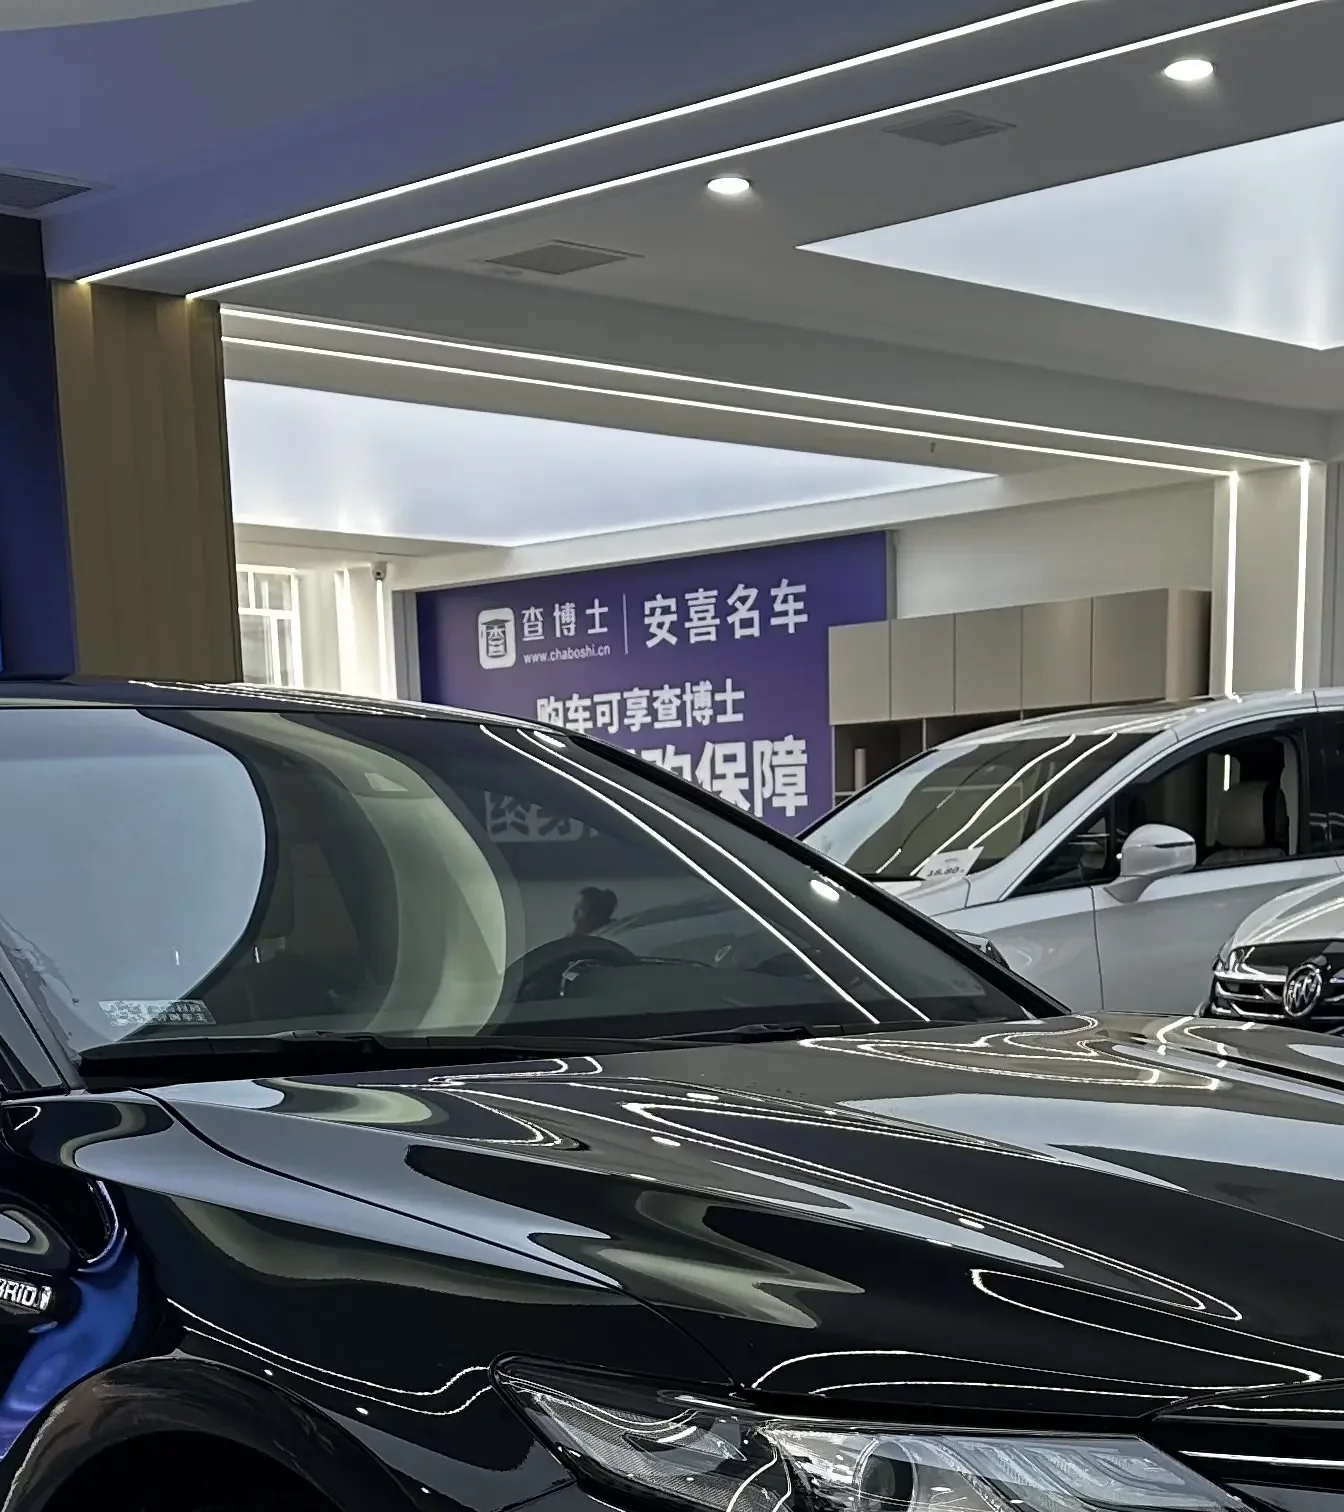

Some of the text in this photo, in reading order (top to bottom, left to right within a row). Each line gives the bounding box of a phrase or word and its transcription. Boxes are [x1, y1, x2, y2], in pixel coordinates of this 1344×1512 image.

[521, 577, 809, 649] 查博士 安喜名车
[522, 643, 612, 664] www.chaboshi.cn
[535, 677, 747, 736] 购车可享查博士
